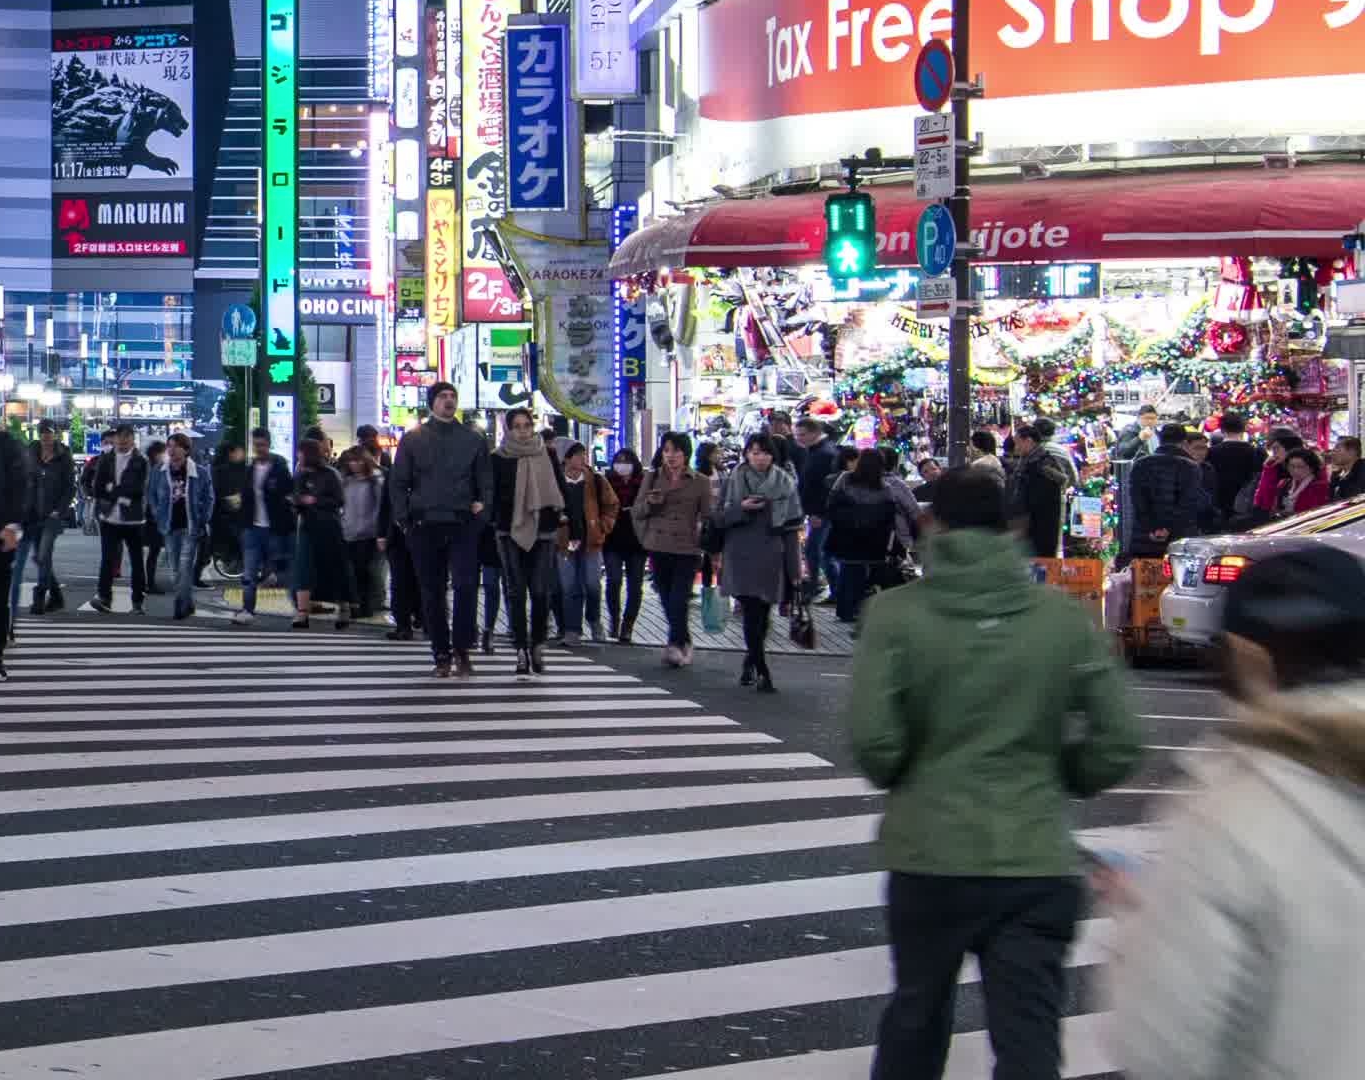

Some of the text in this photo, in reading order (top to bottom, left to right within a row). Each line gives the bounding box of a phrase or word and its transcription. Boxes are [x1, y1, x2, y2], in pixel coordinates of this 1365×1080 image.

[95, 50, 190, 67] 歴代最大ゴジラ
[589, 49, 623, 71] 5F
[766, 16, 814, 88] Tax
[163, 65, 191, 81] 現る
[515, 34, 559, 202] カラオケ
[270, 13, 289, 294] ゴジラロード
[429, 158, 454, 172] 4F
[429, 172, 453, 186] 3F
[97, 202, 185, 225] MARUHAN
[924, 221, 939, 265] P
[468, 271, 503, 300] 2F
[889, 312, 936, 339] MERRY
